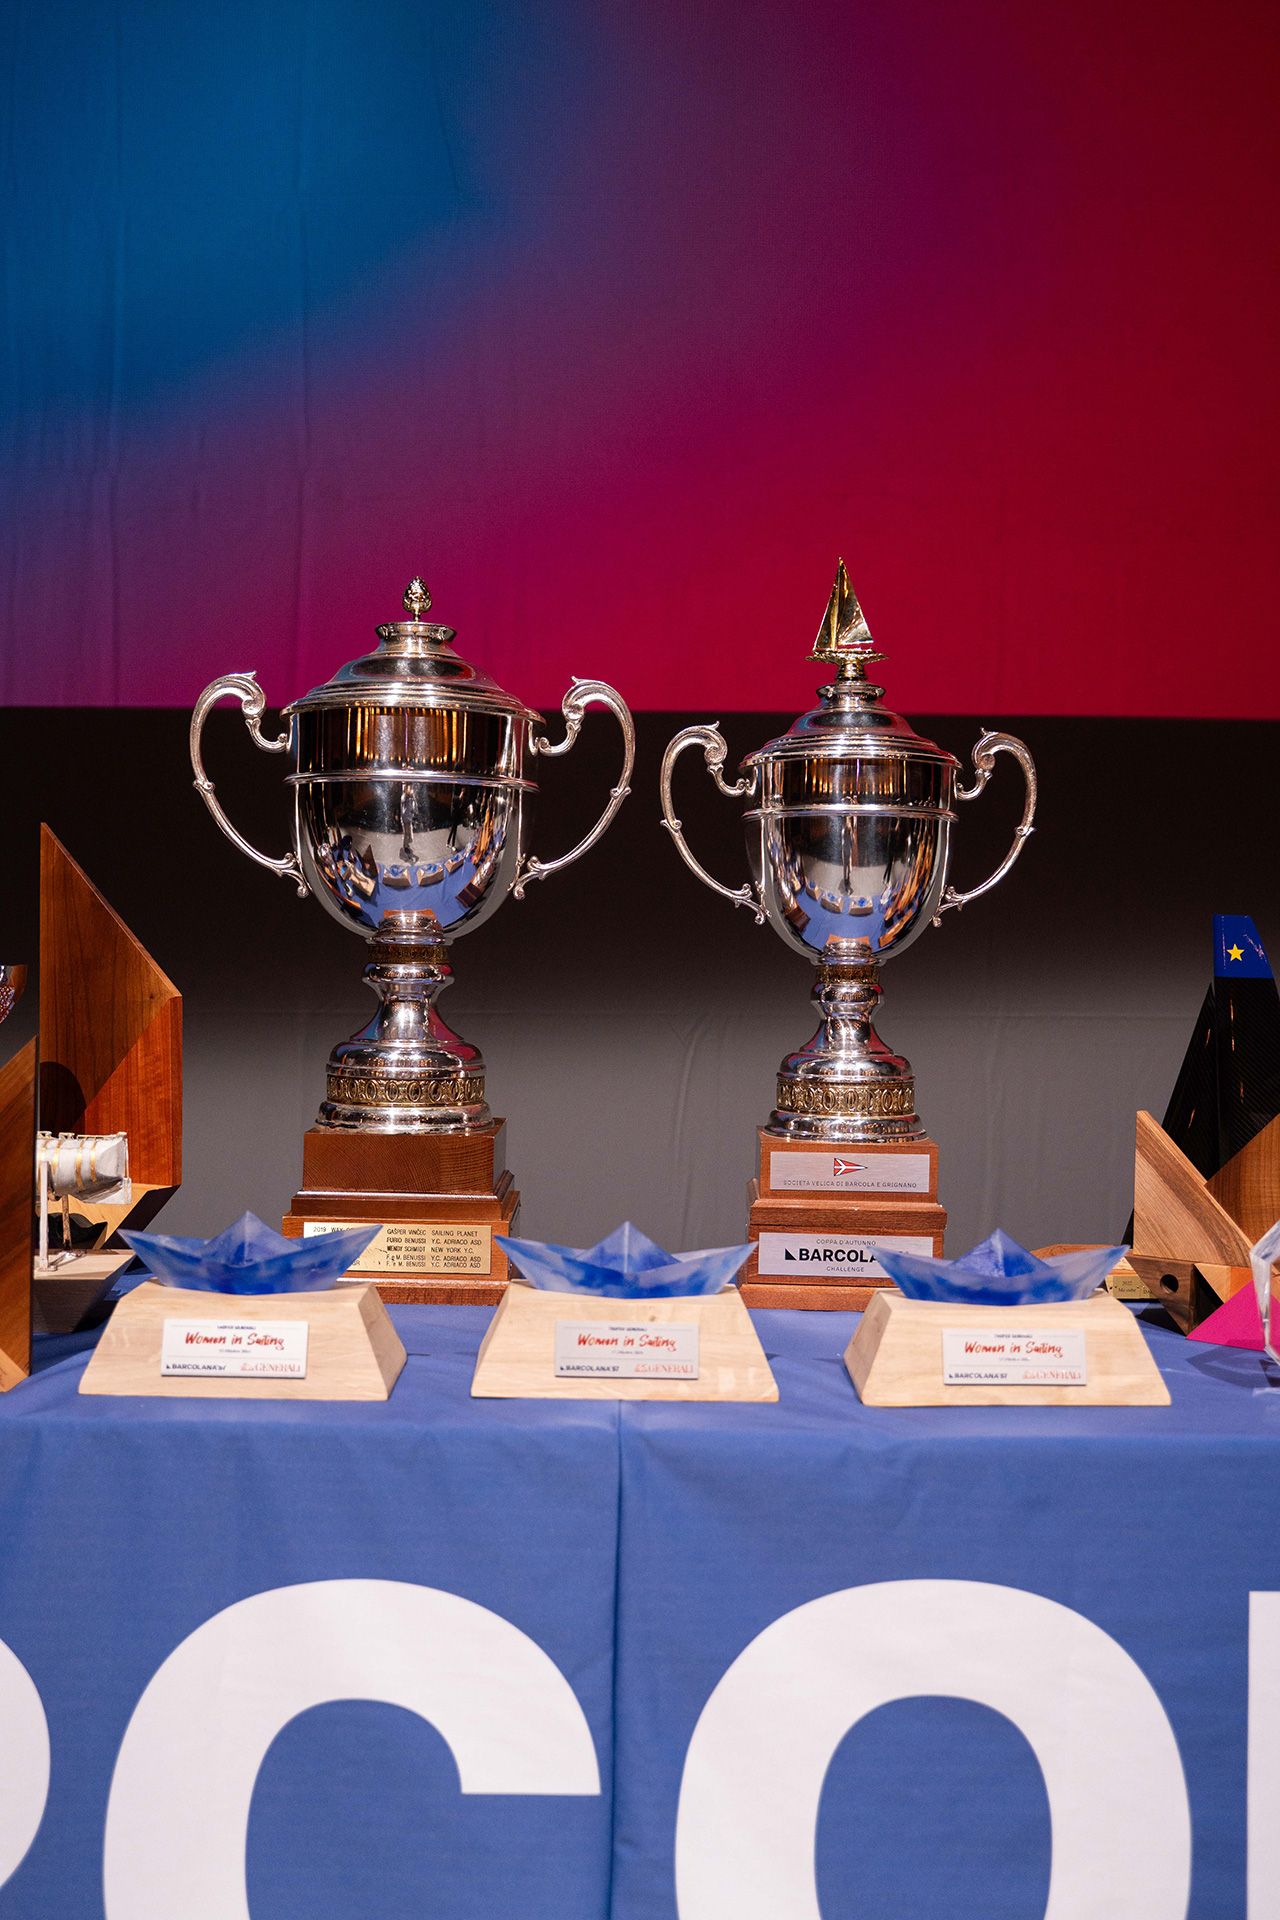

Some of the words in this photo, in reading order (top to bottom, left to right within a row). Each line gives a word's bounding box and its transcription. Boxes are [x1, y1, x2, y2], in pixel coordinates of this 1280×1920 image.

[844, 1180, 875, 1188] BARCOLA
[881, 1181, 917, 1189] GRIGNANO
[431, 1229, 454, 1237] SAILING
[456, 1230, 478, 1238] PLANET
[405, 1260, 426, 1268] BENUSSI
[185, 1331, 227, 1345] Women
[231, 1334, 243, 1345] in
[247, 1332, 285, 1351] Sailing
[577, 1333, 618, 1346] Women
[623, 1335, 634, 1346] in
[639, 1334, 677, 1352] Sailing
[965, 1341, 1005, 1353] Women
[1010, 1342, 1021, 1353] in
[1025, 1341, 1063, 1359] Sailing
